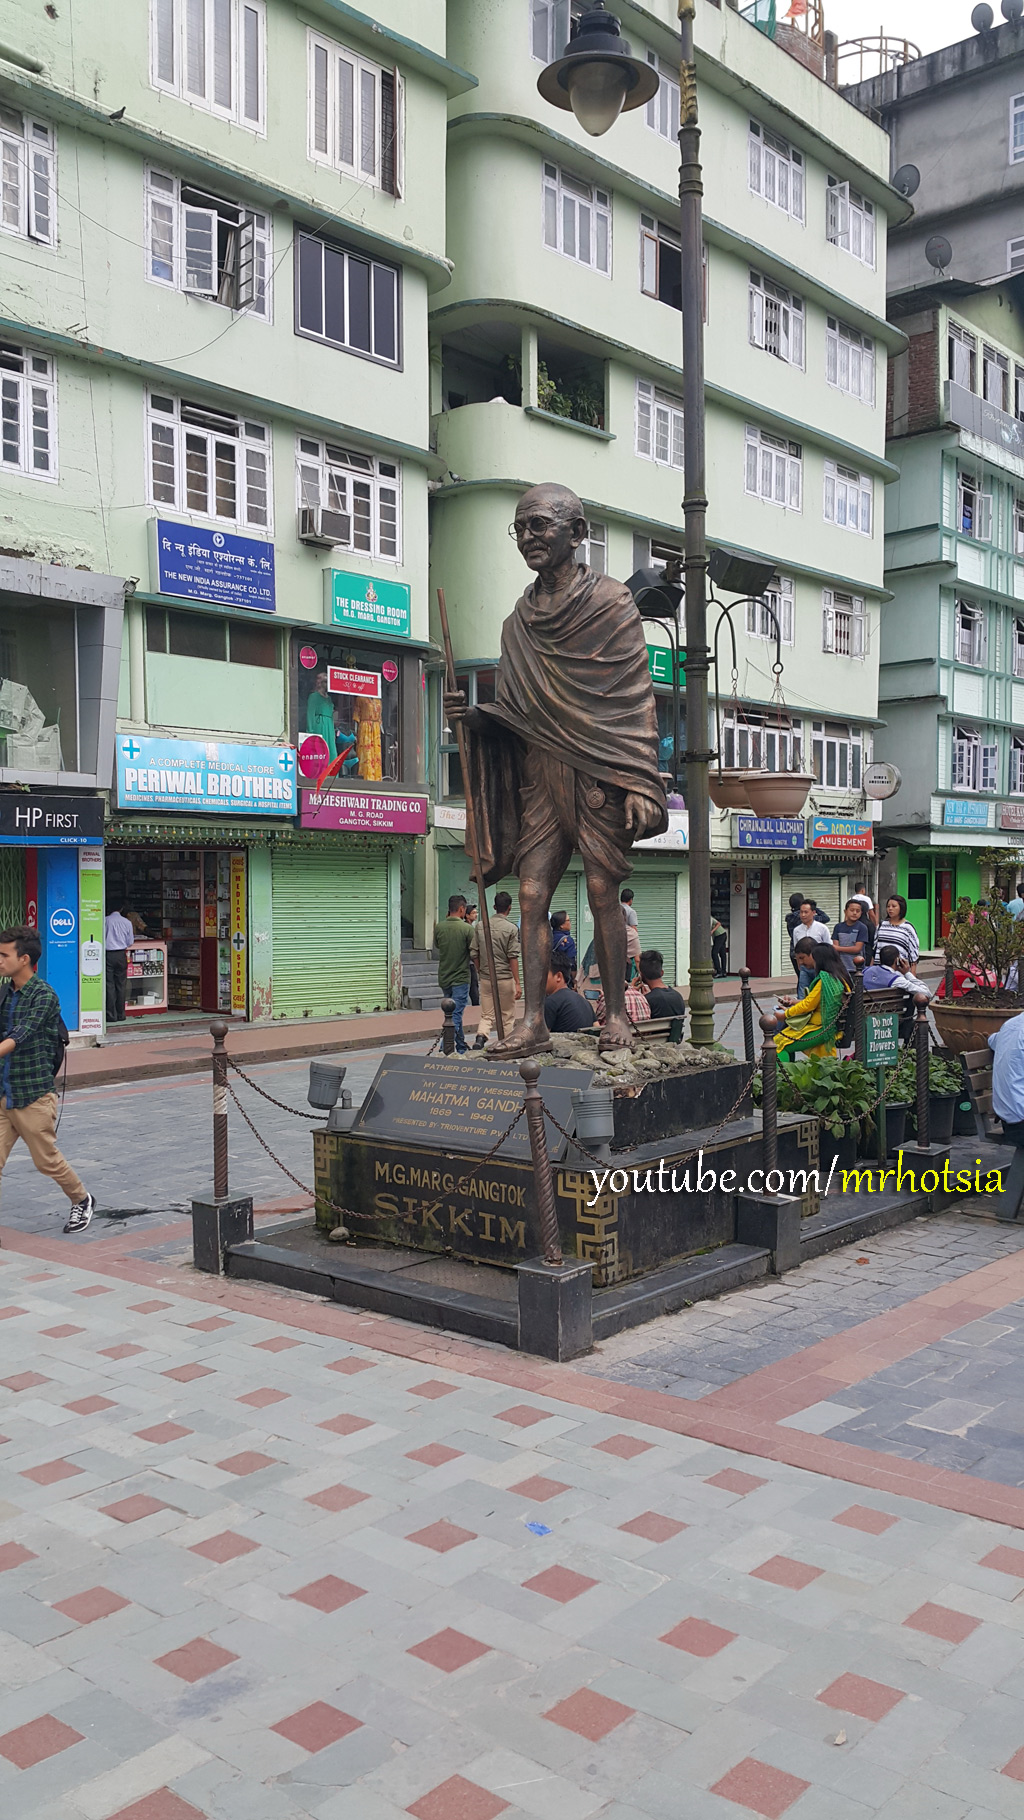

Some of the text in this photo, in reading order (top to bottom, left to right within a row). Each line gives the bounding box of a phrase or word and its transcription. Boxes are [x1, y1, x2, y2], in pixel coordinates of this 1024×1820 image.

[162, 537, 172, 551] दि
[174, 543, 186, 557] न्यू
[188, 543, 210, 558] इंडिया
[164, 570, 272, 597] THE NEW INDIA ASSURANCE CO. LTD.
[336, 596, 407, 619] THE DRESSING ROOM
[377, 615, 401, 626] GANGTOK
[333, 671, 375, 684] STOCK CLEARANCE
[301, 753, 326, 761] enamor
[149, 757, 275, 775] A COMPLETE MEDICAL STORE
[125, 767, 293, 800] PERIWAL BROTHERS
[230, 799, 253, 808] SURGICAL
[258, 801, 279, 809] HOSPITAL
[308, 793, 422, 813] MAHESHWARI TRADING CO.
[15, 806, 79, 828] HP FIRST
[339, 817, 394, 828] GANGTOK, SIKKIM
[366, 811, 384, 819] ROAD
[458, 811, 466, 821] D
[740, 819, 774, 833] CHIRANJILAL
[775, 821, 803, 834] LALCHAND
[819, 836, 867, 847] AMUSEMENT
[53, 918, 73, 926] DELL
[872, 1016, 893, 1028] Do not
[874, 1028, 892, 1040] Pluck
[869, 1041, 896, 1052] Flowers
[424, 1062, 460, 1073] FATHER
[476, 1067, 497, 1076] THE
[500, 1069, 520, 1077] NAT
[439, 1081, 459, 1091] LIFE
[468, 1085, 482, 1093] MY
[483, 1086, 525, 1098] MESSAGE
[408, 1089, 528, 1114] MAHATMA GANDH
[429, 1106, 452, 1117] 1869
[470, 1112, 494, 1123] 1948
[392, 1116, 427, 1128] PRESENTED
[440, 1123, 489, 1137] TRIOVENTURE
[373, 1191, 527, 1249] SIKKIM
